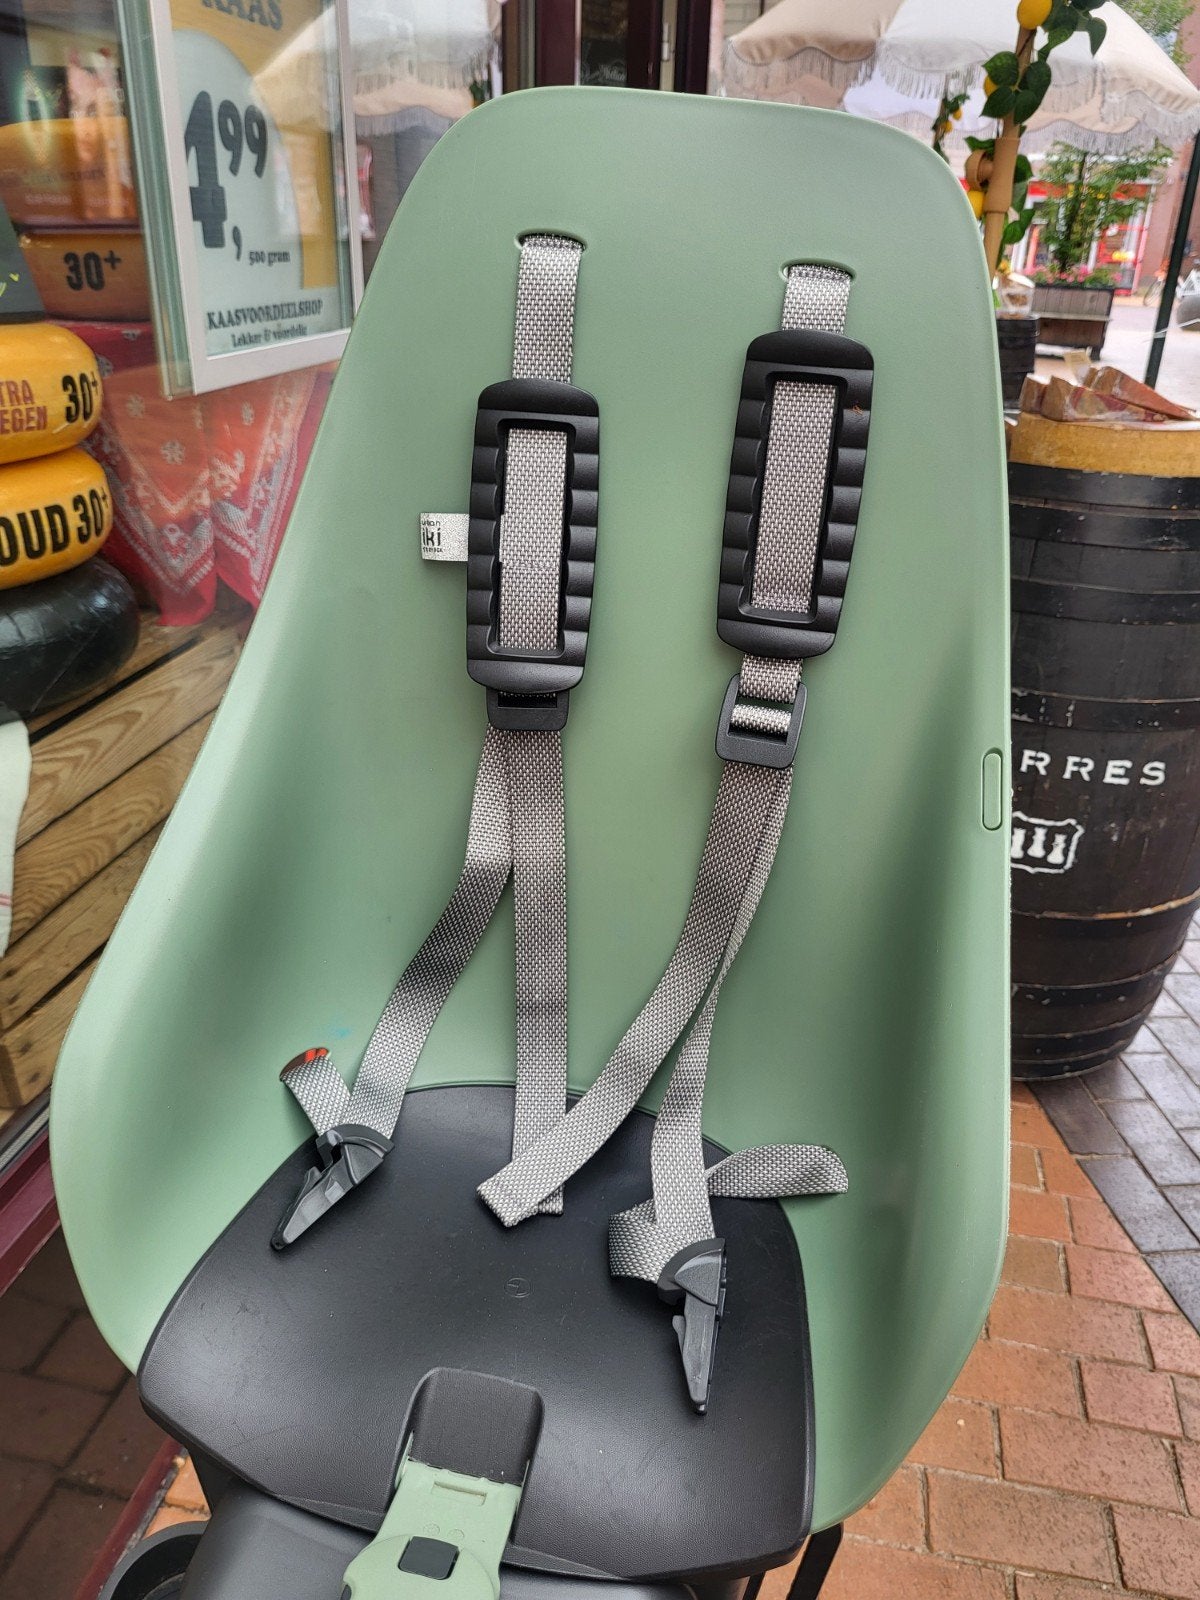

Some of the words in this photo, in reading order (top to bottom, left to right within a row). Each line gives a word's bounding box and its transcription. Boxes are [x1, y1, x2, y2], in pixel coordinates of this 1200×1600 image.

[202, 0, 283, 31] AS
[63, 250, 121, 291] 30+
[249, 250, 266, 266] 500
[268, 251, 291, 267] gram
[207, 299, 323, 330] KAASVOORDEELSHOP
[231, 333, 261, 348] Lekker
[62, 371, 99, 423] 30+
[72, 486, 109, 544] 30+
